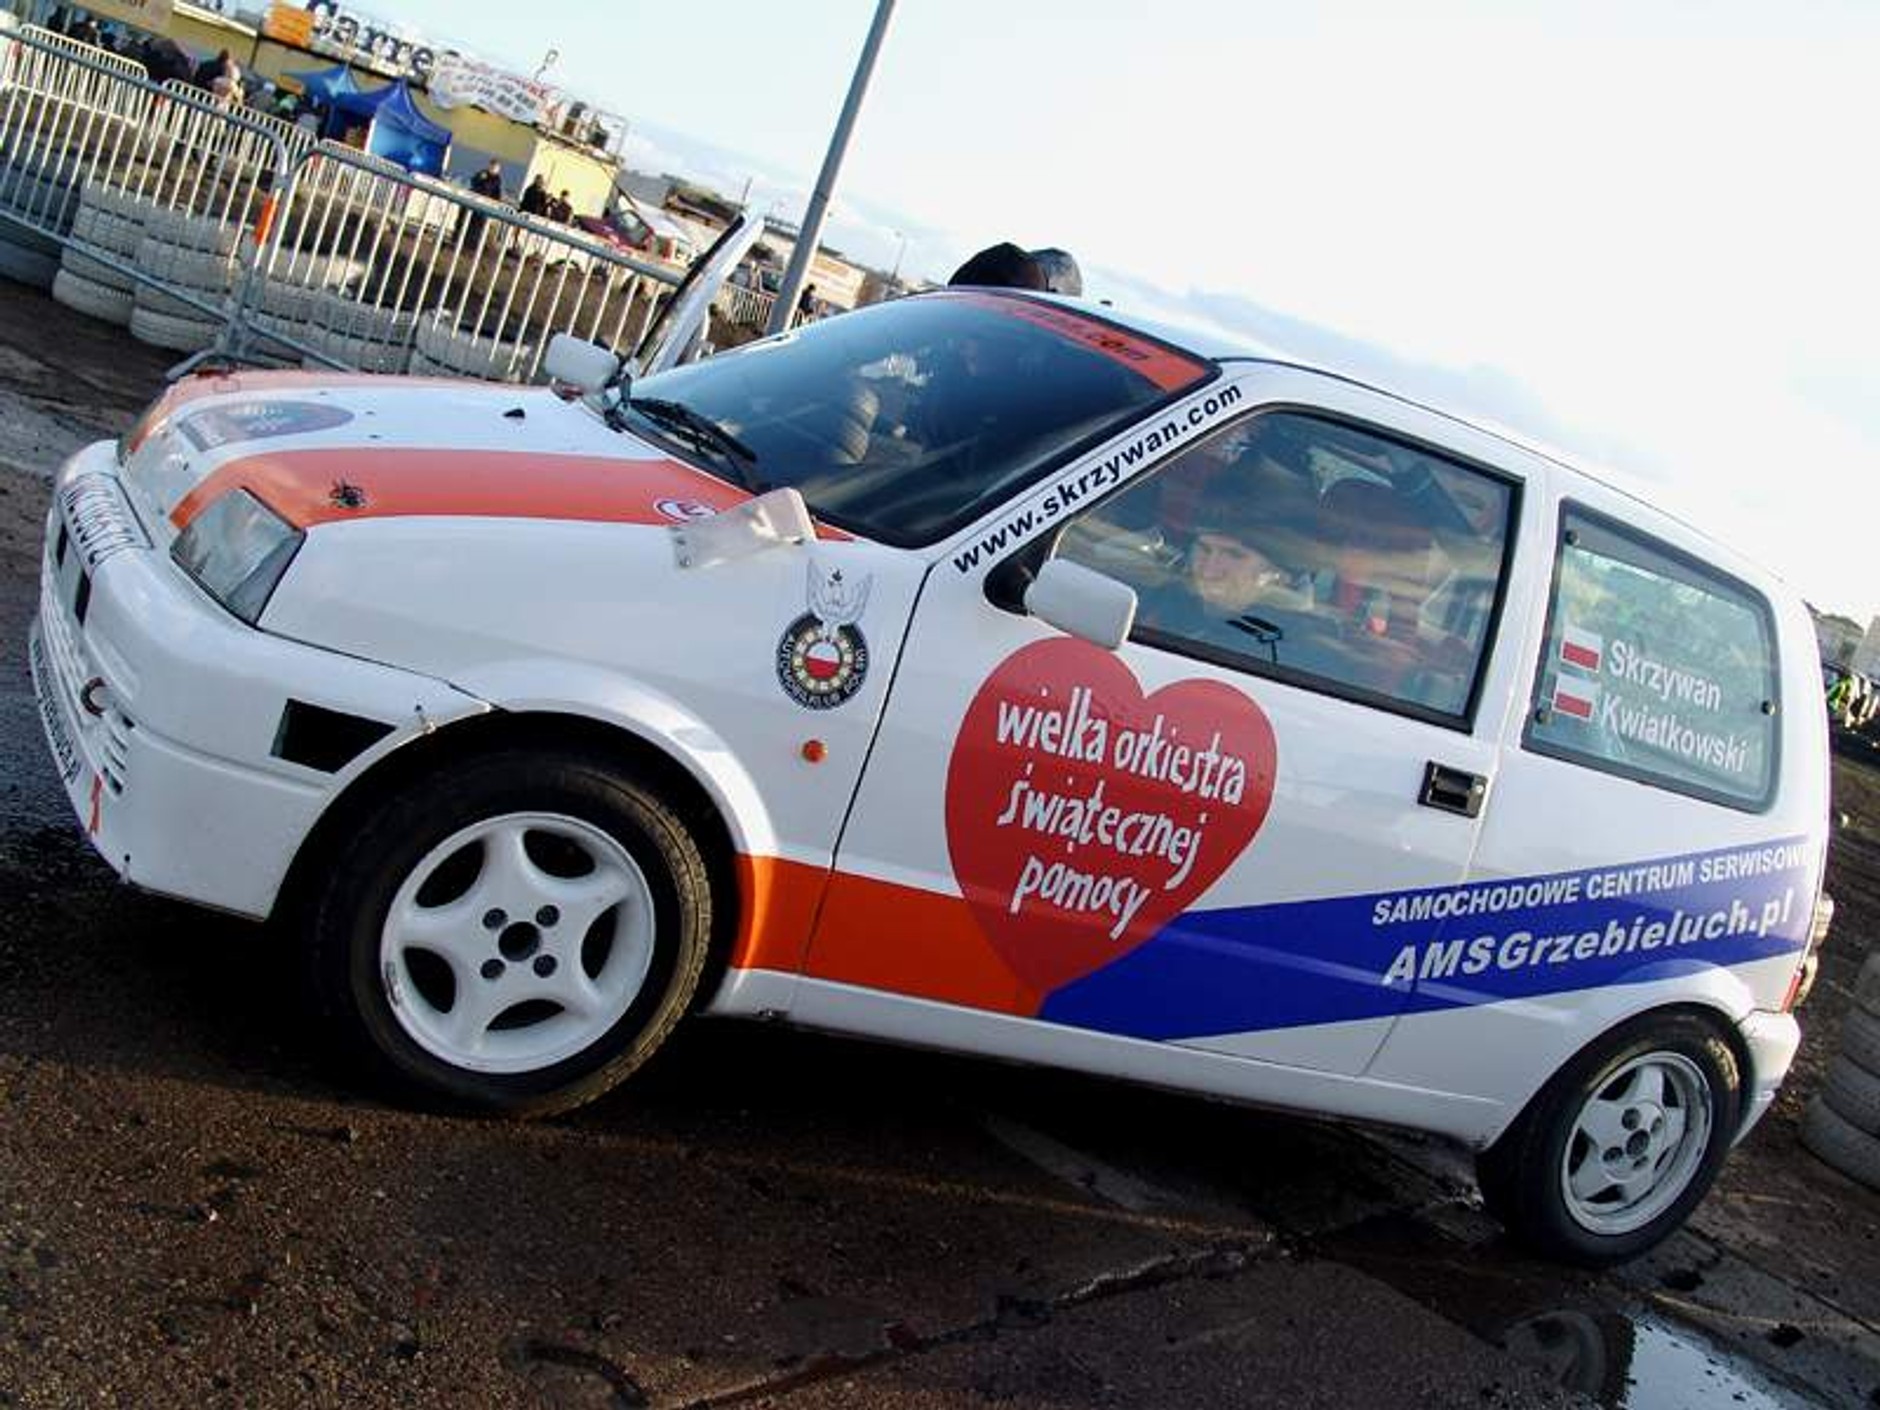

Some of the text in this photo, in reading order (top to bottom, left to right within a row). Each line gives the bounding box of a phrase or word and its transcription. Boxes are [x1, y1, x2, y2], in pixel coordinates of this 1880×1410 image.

[307, 0, 460, 75] Carre
[953, 384, 1242, 574] www.skrzywan.com
[1609, 639, 1721, 712] Skrzywan
[996, 685, 1246, 806] wielka orkiestra
[1600, 692, 1750, 772] Kwiatkowski
[996, 762, 1207, 891] świątecznej
[1009, 854, 1151, 941] pomocy
[1372, 877, 1581, 926] SAMOCHODOWE
[1586, 861, 1695, 900] CENTRUM
[1381, 887, 1794, 987] AMSGrzebieluch.pl
